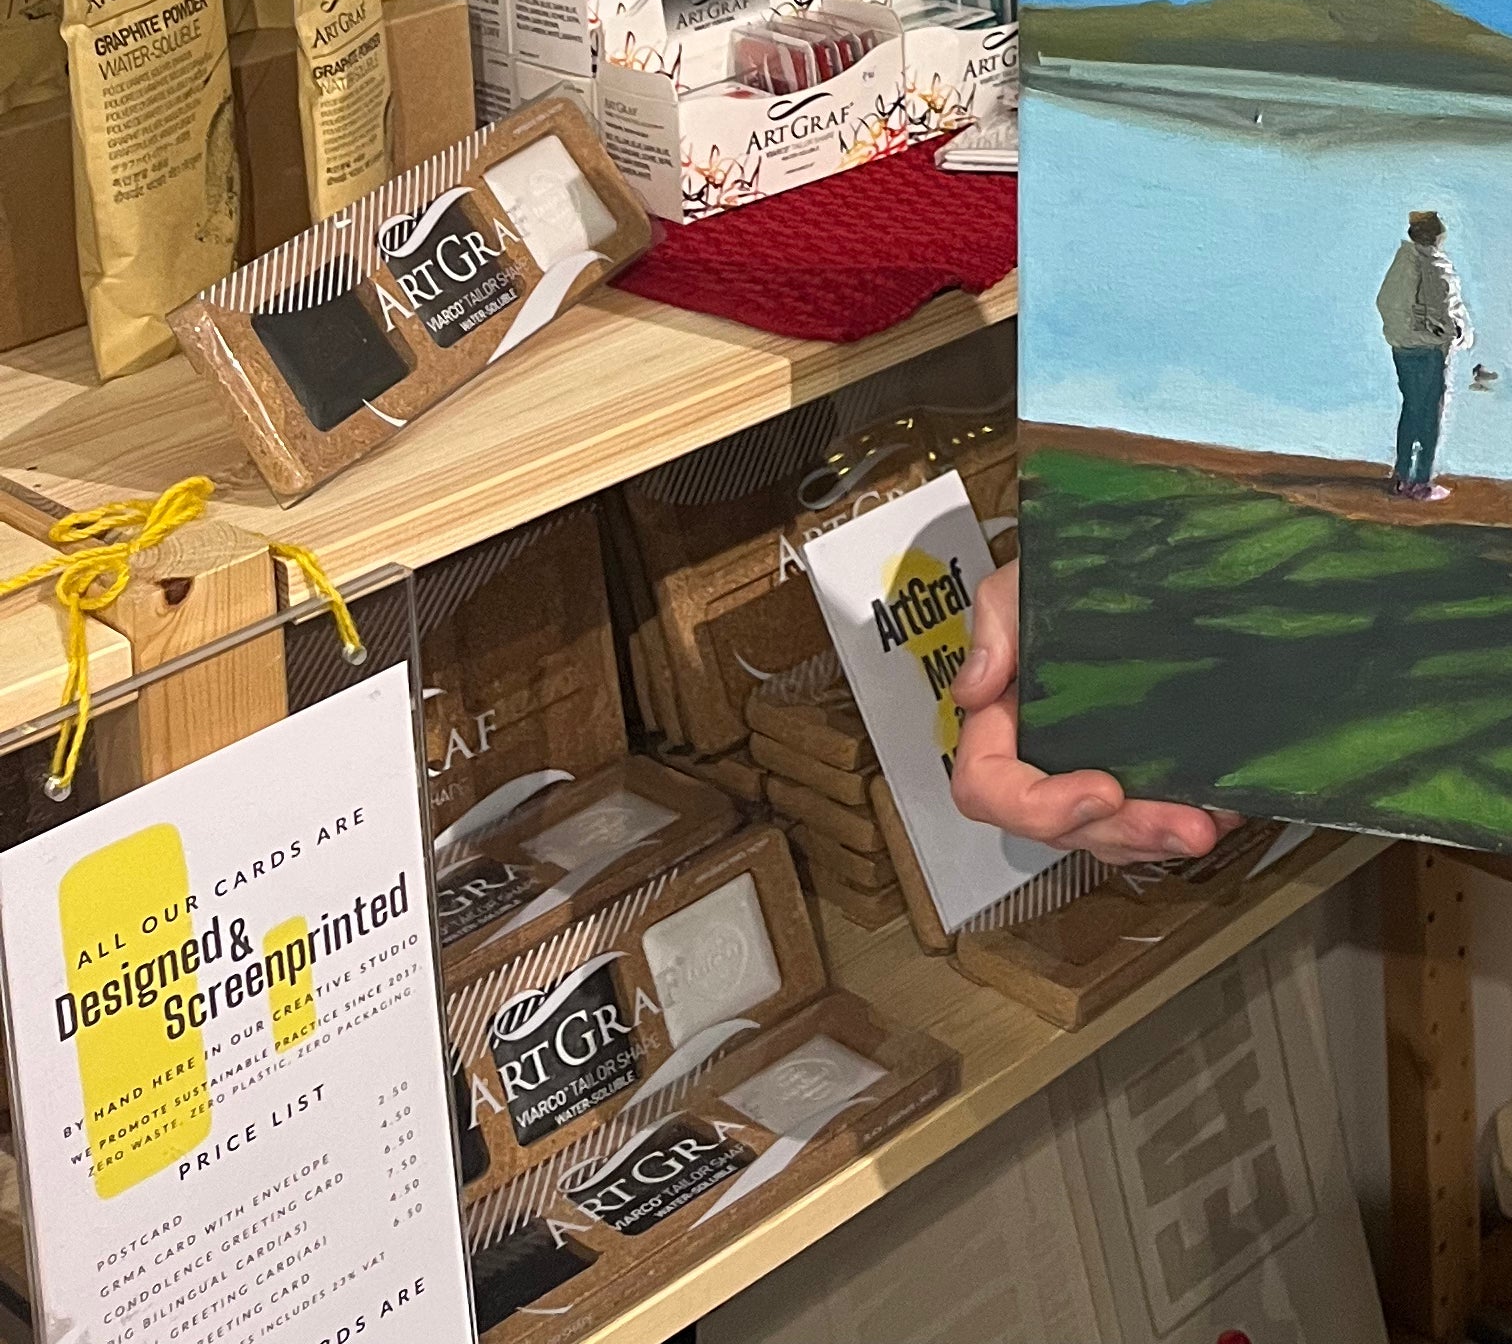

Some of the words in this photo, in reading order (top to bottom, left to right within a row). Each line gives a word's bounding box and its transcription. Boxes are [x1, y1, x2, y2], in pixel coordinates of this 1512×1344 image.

[94, 13, 166, 57] GRAPHITE
[98, 19, 202, 81] WATER-SOLUBLE
[375, 212, 524, 333] ARTGRA
[871, 556, 972, 653] ArtGraf
[77, 932, 127, 970] ALL
[142, 895, 199, 935] OUR
[214, 840, 302, 898] CARDS
[316, 807, 365, 846] ARE
[55, 915, 223, 1042] Designed
[230, 917, 254, 963] &
[164, 871, 410, 1041] Screenprinted
[63, 1120, 84, 1140] BY
[93, 1087, 144, 1123] HAND
[152, 1057, 196, 1090] HERE
[203, 1042, 222, 1062] IN
[230, 1020, 265, 1047] OUR
[272, 970, 353, 1023] CREATIVE
[360, 933, 419, 975] STUDIO
[70, 1146, 93, 1166] WE
[99, 1103, 168, 1151] PROMOTE
[175, 1048, 269, 1109] SUSTAINABLE
[275, 1008, 339, 1054] PRACTICE
[344, 985, 383, 1012] SINCE
[468, 986, 665, 1131] ARTGRA
[88, 1150, 125, 1179] ZERO
[190, 1092, 226, 1119] ZERO
[298, 1031, 332, 1060] ZERO
[178, 1123, 257, 1182] PRICE
[271, 1083, 325, 1128] LIST
[554, 1070, 637, 1125] WATER-SOLUBLE
[546, 1119, 748, 1250] ARTGRA
[709, 1143, 746, 1169] SHAP
[96, 1215, 183, 1273] POSTCARD
[99, 1264, 147, 1299] GRMA
[154, 1234, 197, 1266] CARD
[204, 1205, 246, 1236] WITH
[252, 1153, 330, 1207] ENVELOPE
[103, 1249, 214, 1326] CONDOLENCE
[220, 1199, 298, 1253] GREETING
[304, 1172, 344, 1203] CARD
[142, 1270, 228, 1330] BILINGUAL
[169, 1283, 249, 1340] GREETING
[261, 1289, 326, 1336] INCLUDES
[362, 1250, 387, 1273] VAT
[269, 1272, 310, 1305] CARD
[319, 1315, 367, 1344] DS
[380, 1276, 426, 1319] ARE
